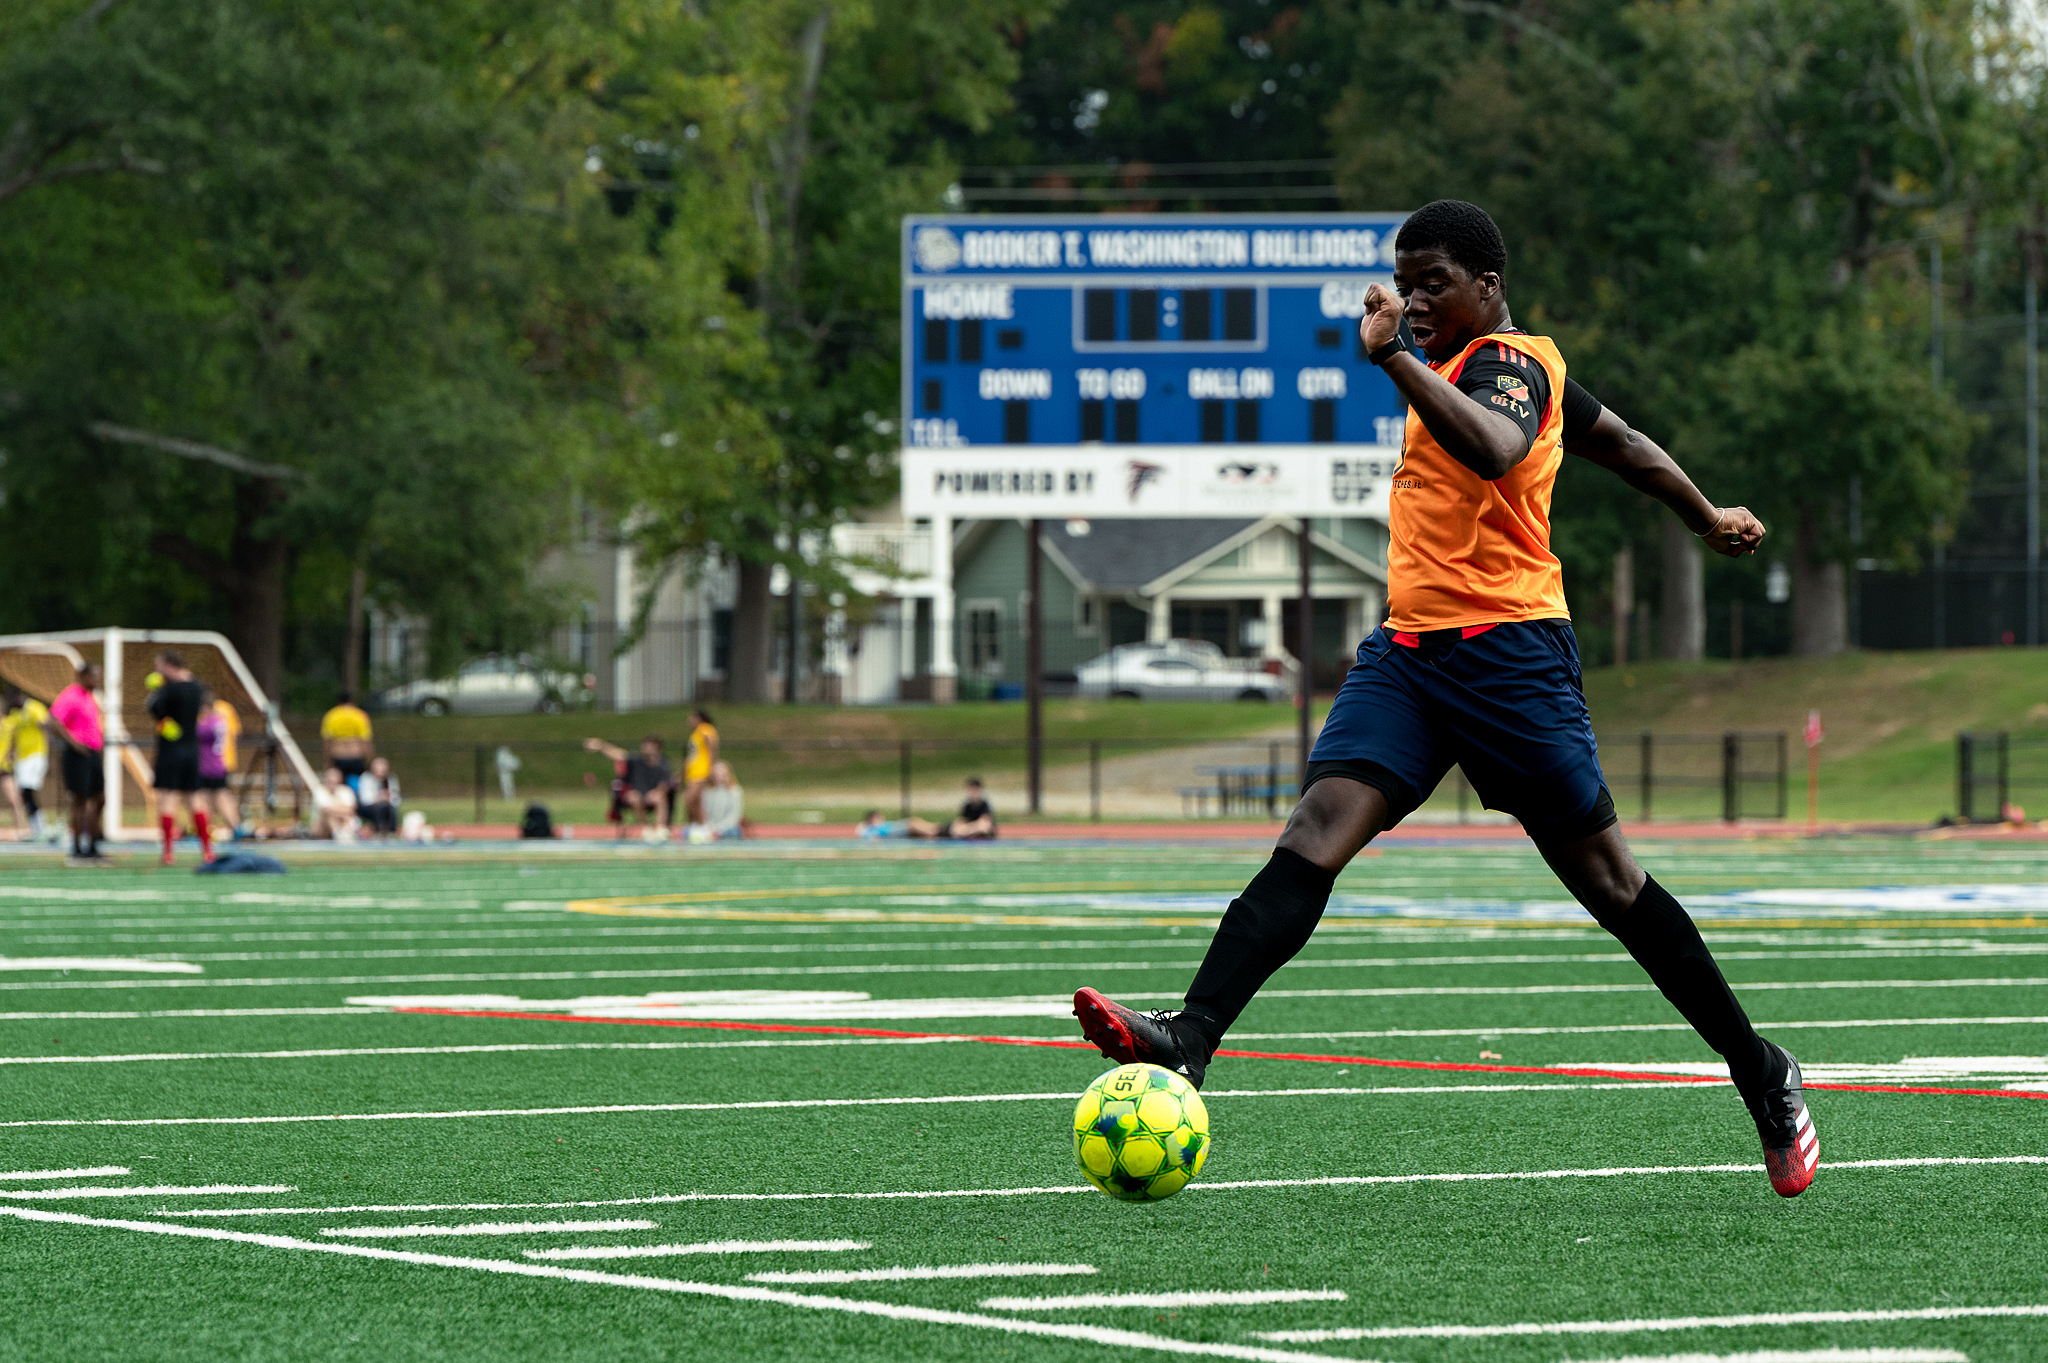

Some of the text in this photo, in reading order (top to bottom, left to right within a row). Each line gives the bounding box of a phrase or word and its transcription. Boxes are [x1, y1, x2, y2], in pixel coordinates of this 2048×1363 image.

[962, 230, 1379, 268] BOOKER T. WASHINGTON BULLDOGS
[923, 284, 1015, 320] HOME
[979, 368, 1052, 400] DOWN
[1077, 368, 1147, 400] TO GO
[1188, 368, 1275, 400] BALL ON
[1298, 367, 1347, 400] QTR
[1501, 377, 1518, 387] MLS
[935, 471, 1095, 496] POWERED BY
[1414, 481, 1422, 489] FC
